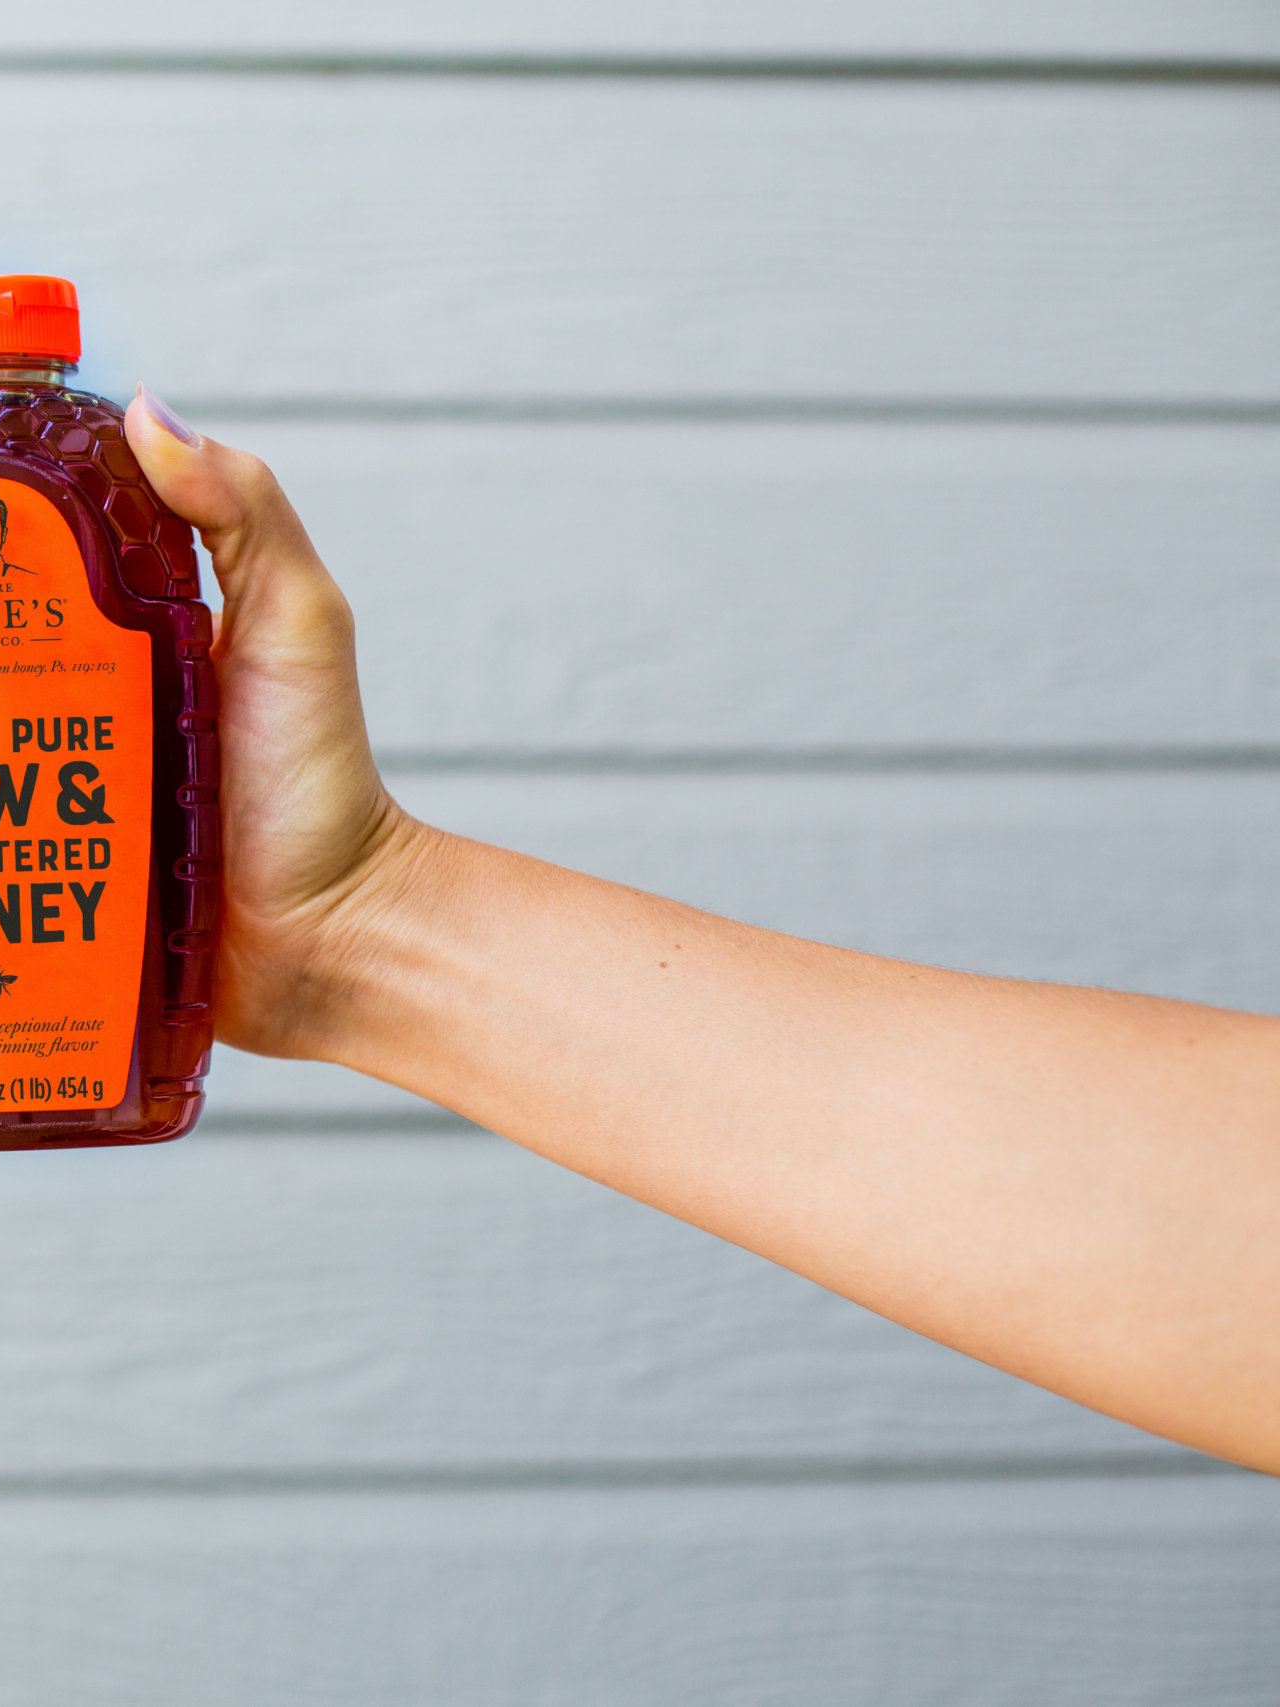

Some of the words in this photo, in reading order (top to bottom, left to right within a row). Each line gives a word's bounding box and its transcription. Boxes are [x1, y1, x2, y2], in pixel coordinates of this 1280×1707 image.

[0, 636, 24, 646] CO.
[12, 661, 48, 677] honey.
[51, 660, 67, 672] Ps.
[72, 661, 116, 674] 119:103
[12, 716, 114, 752] PURE
[56, 760, 115, 825] &
[70, 1018, 104, 1031] taste
[47, 1037, 98, 1057] flavor
[10, 1079, 25, 1103] (1
[30, 1078, 52, 1102] lb)
[57, 1077, 88, 1099] 454
[93, 1080, 104, 1100] g
